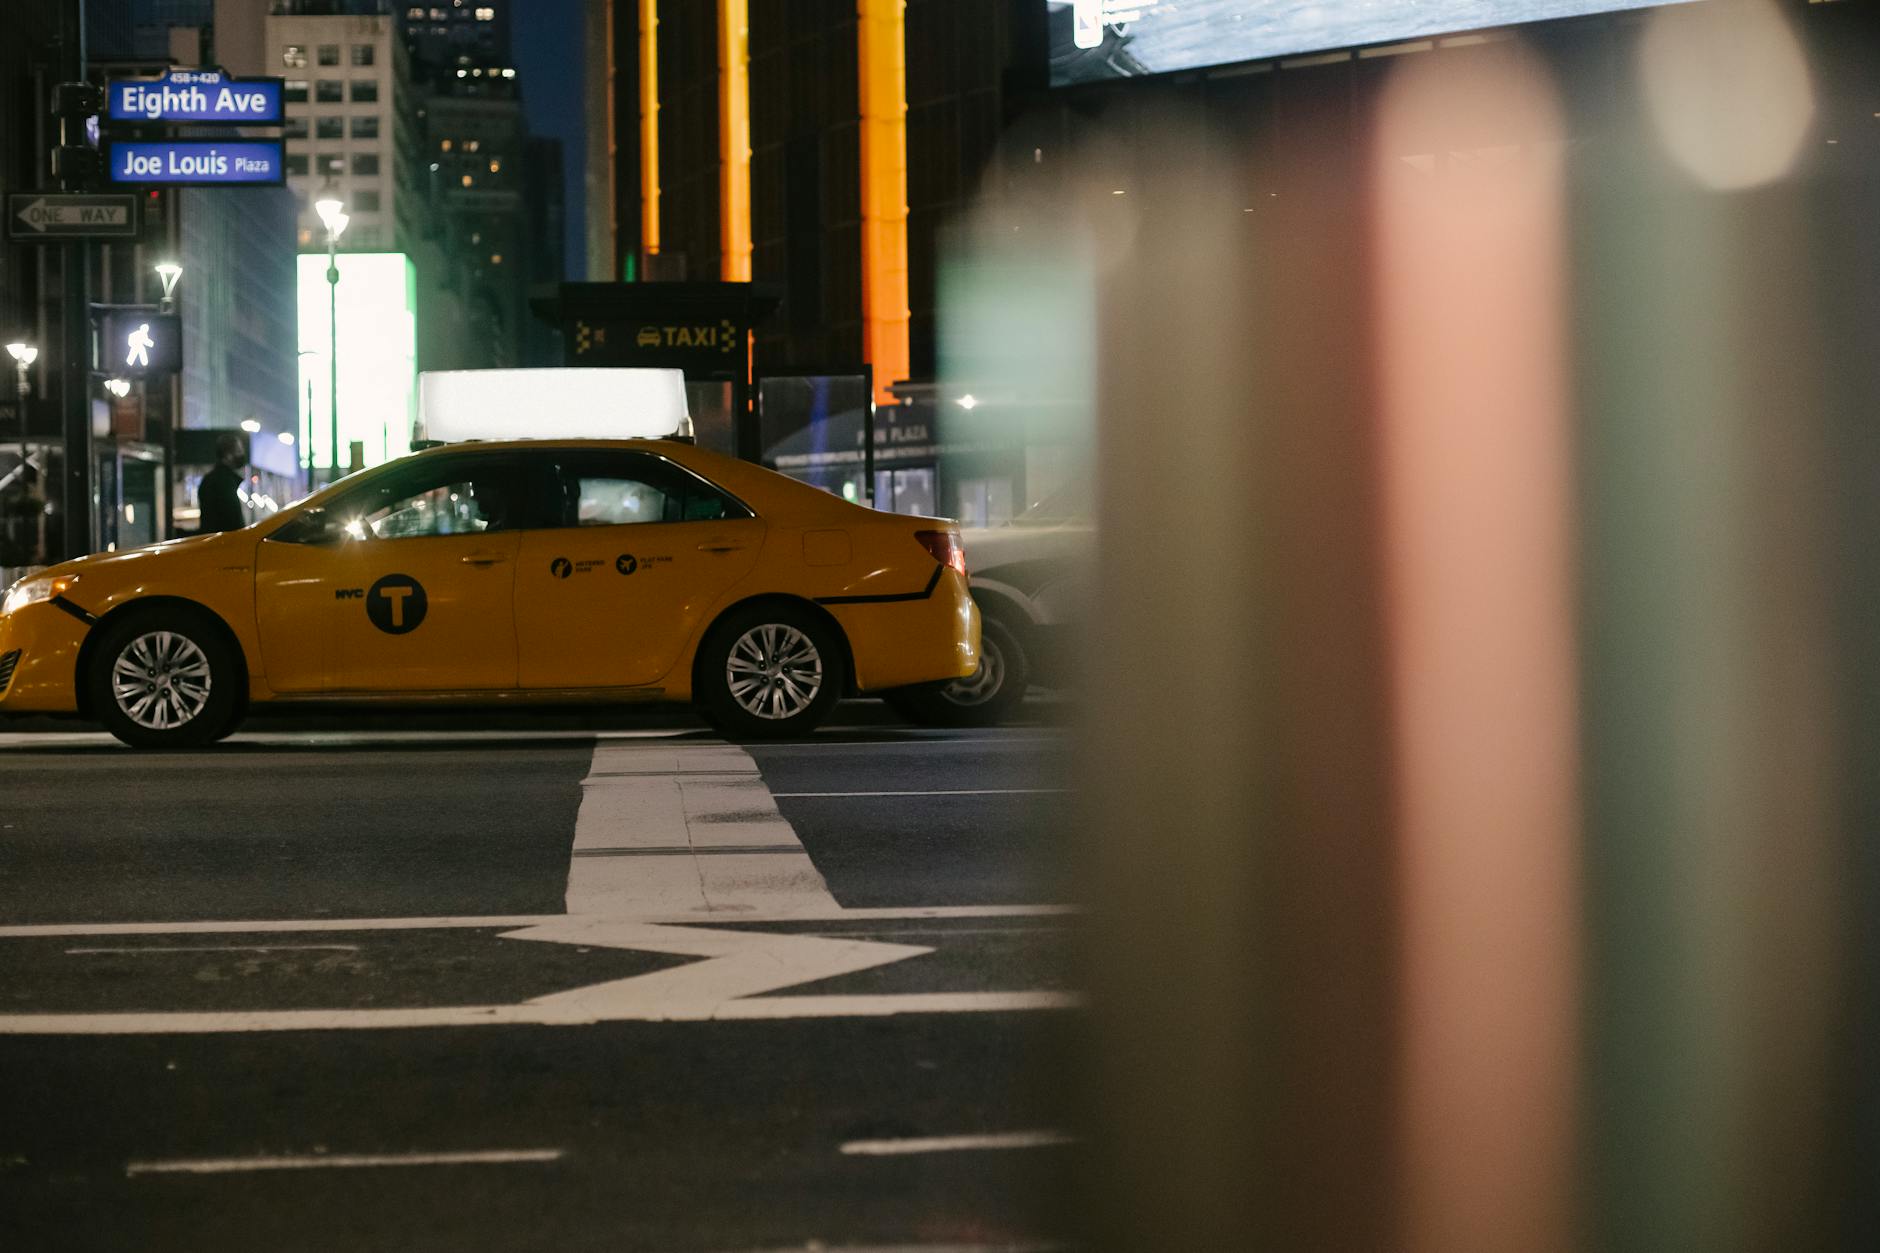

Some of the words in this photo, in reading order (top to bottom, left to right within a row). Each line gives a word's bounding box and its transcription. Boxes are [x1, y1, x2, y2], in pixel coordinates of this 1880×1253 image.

[122, 87, 207, 119] Eighth
[215, 89, 267, 113] Ave
[123, 151, 162, 175] Joe
[169, 150, 228, 175] Louis
[235, 158, 269, 173] Plaza
[30, 207, 63, 223] ONE
[80, 207, 117, 223] WAY
[663, 326, 717, 347] TAXI
[891, 424, 929, 442] PLAZA
[335, 589, 364, 600] NYC
[380, 586, 413, 627] T
